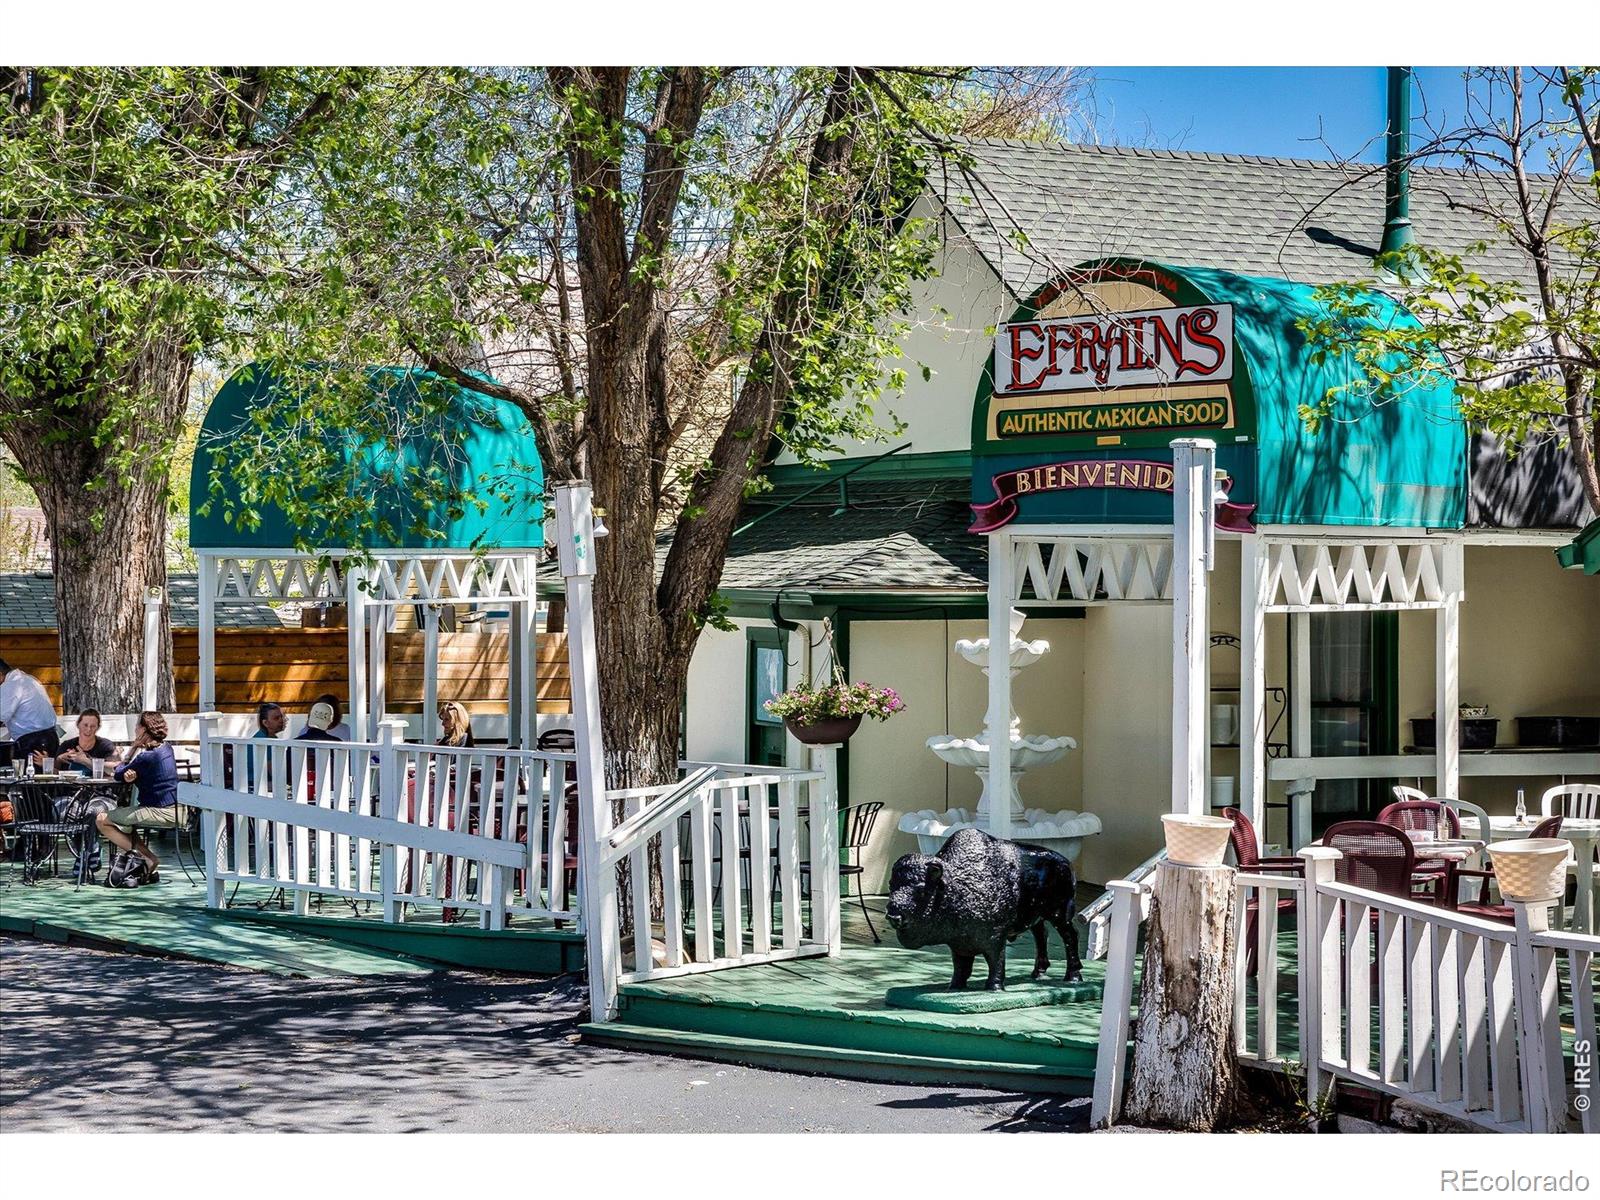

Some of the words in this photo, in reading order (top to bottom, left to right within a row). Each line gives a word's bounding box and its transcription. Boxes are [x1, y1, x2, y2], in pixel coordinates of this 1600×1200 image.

[1004, 307, 1227, 391] EFRAINS
[1002, 410, 1092, 434] AUTHENTIC
[1095, 406, 1174, 428] MEXICAN
[1176, 402, 1225, 425] FOOD
[1016, 462, 1174, 494] BIENVENID
